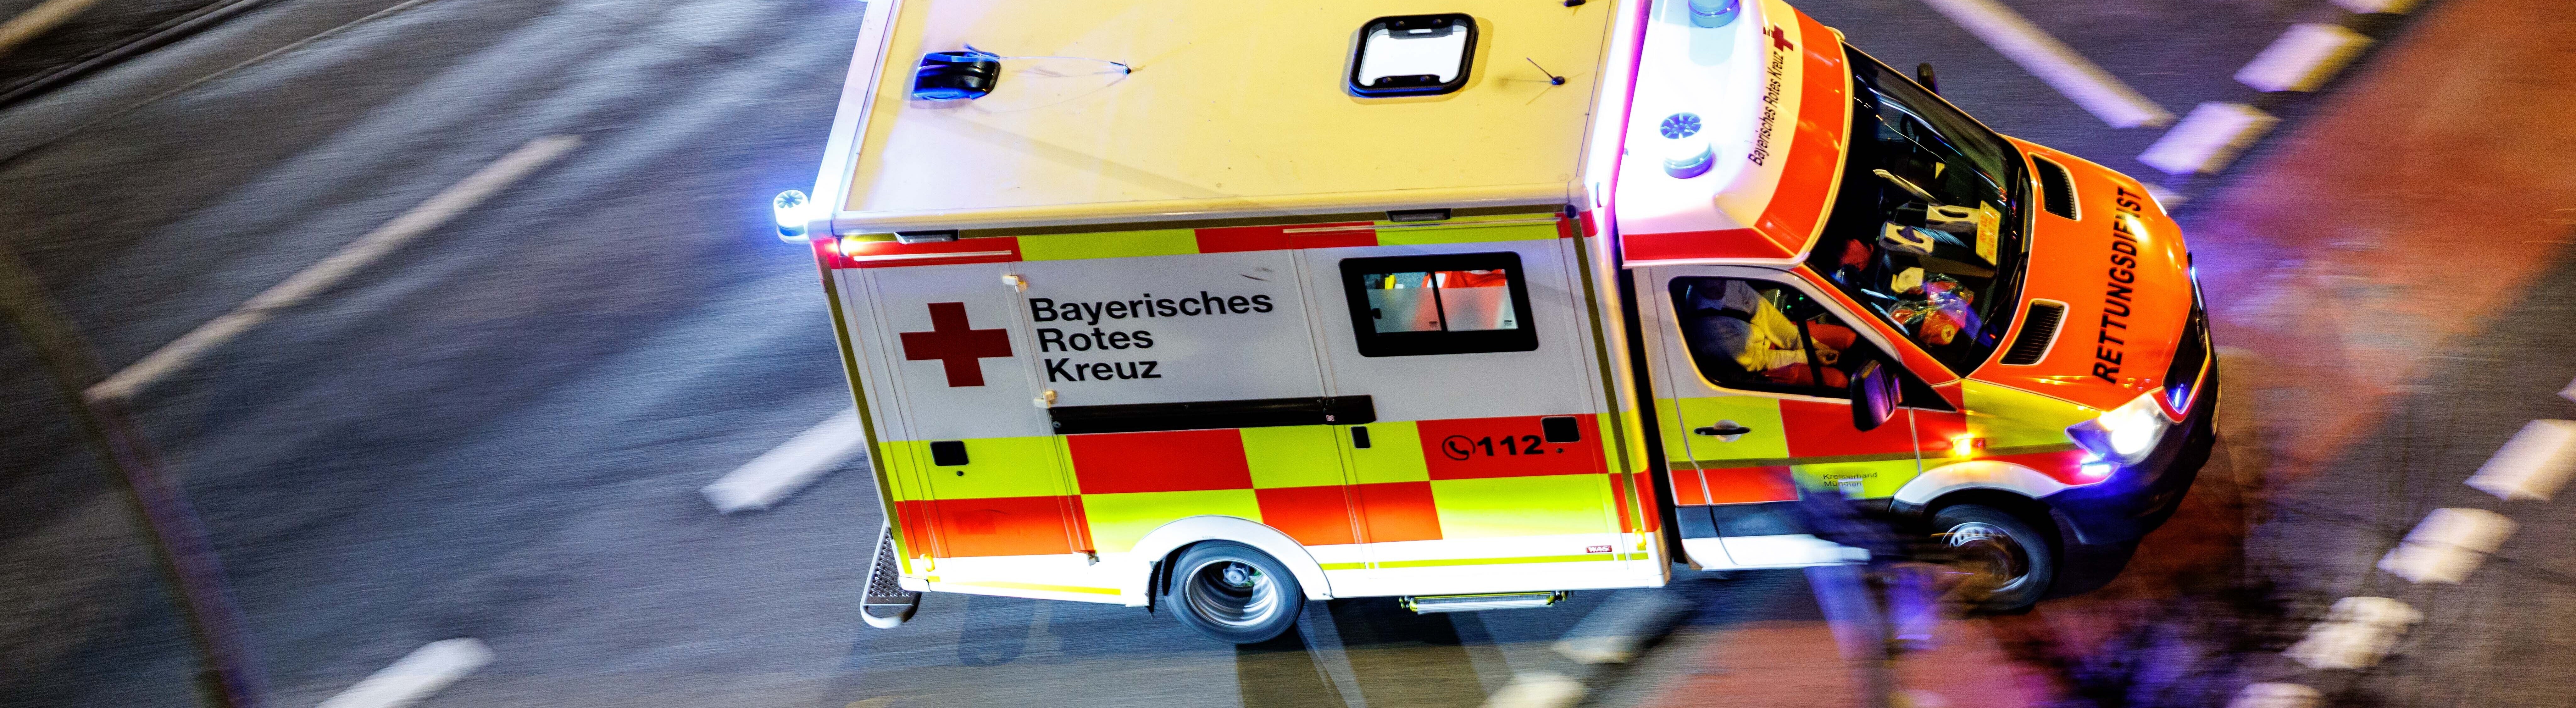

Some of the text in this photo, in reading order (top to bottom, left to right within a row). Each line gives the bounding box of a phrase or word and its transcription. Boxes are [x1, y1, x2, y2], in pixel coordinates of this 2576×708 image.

[1747, 51, 1784, 166] Bayerisches Rotes Kreuz
[1029, 290, 1274, 326] Bayerisches
[1037, 327, 1154, 352] Rotes
[1044, 357, 1161, 383] Kreuz
[1477, 435, 1544, 456] 112
